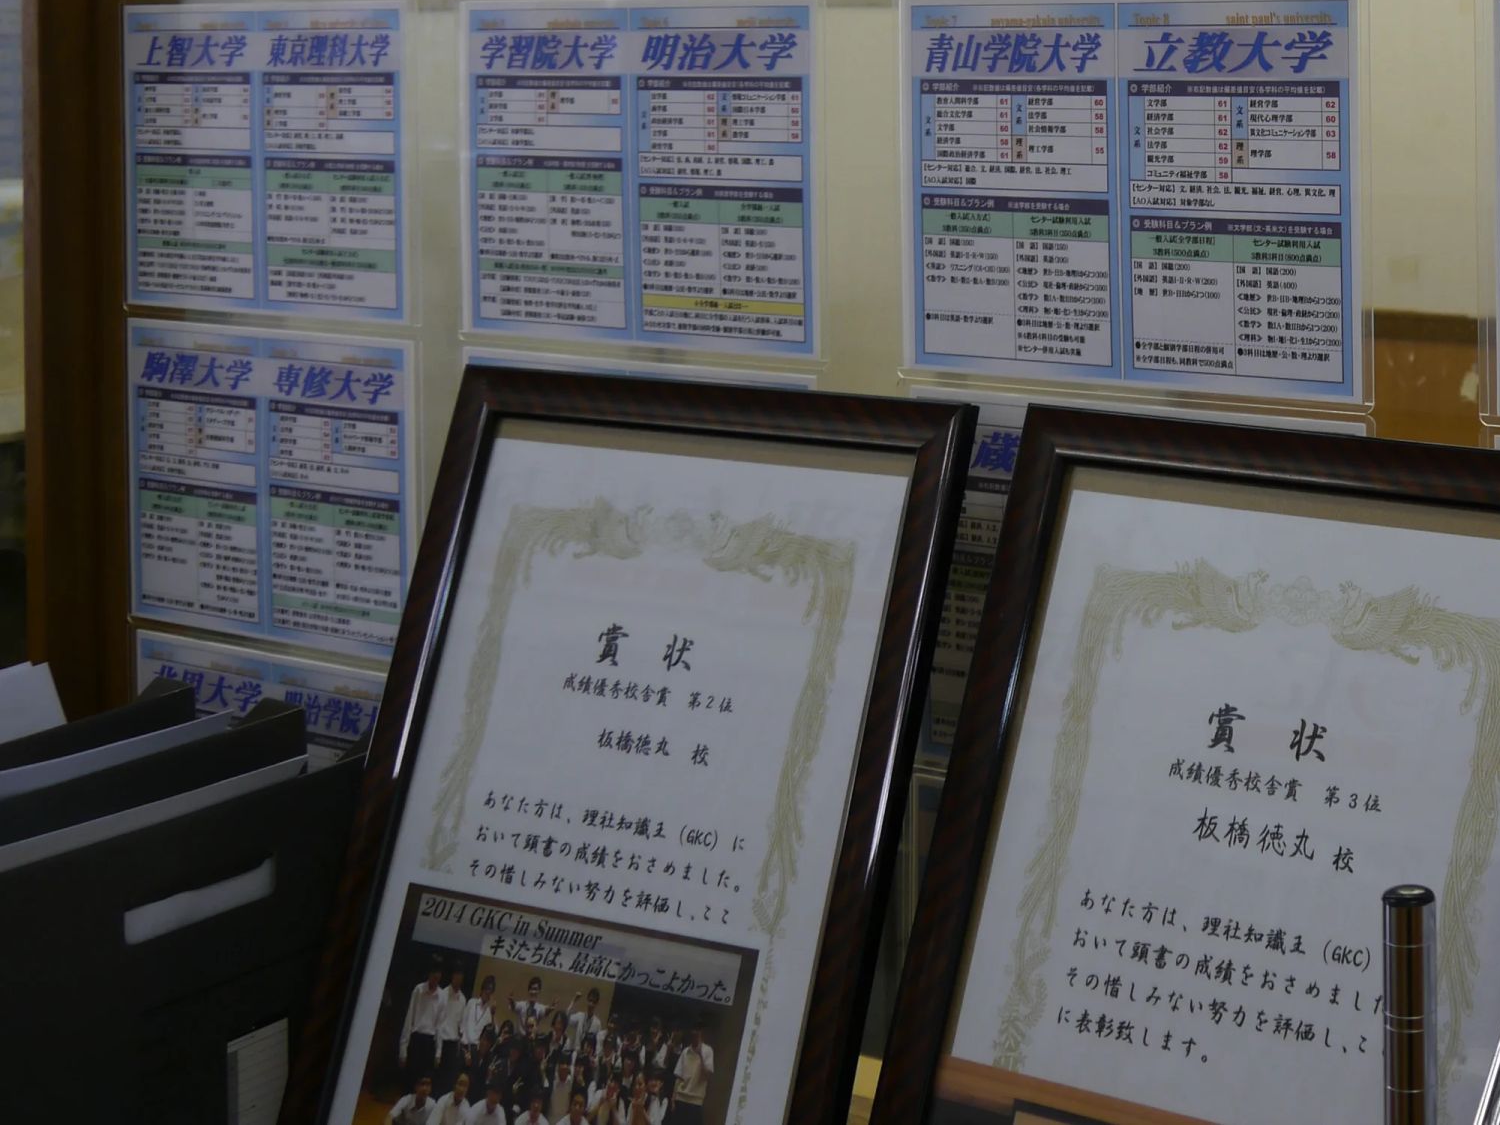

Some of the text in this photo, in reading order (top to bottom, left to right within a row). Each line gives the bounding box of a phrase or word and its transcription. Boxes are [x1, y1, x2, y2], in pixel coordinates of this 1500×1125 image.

[138, 35, 246, 69] 上智大学
[266, 34, 391, 69] 東京理科大学
[480, 35, 618, 70] 学習院大学
[641, 32, 796, 72] 明治大学
[925, 33, 1101, 73] 青山学院大学
[1134, 31, 1333, 73] 立教大学
[141, 350, 254, 391] 駒澤大学
[273, 367, 394, 406] 専修大学
[1333, 847, 1355, 874] 校
[421, 897, 602, 952] 2014 GKC in Summer
